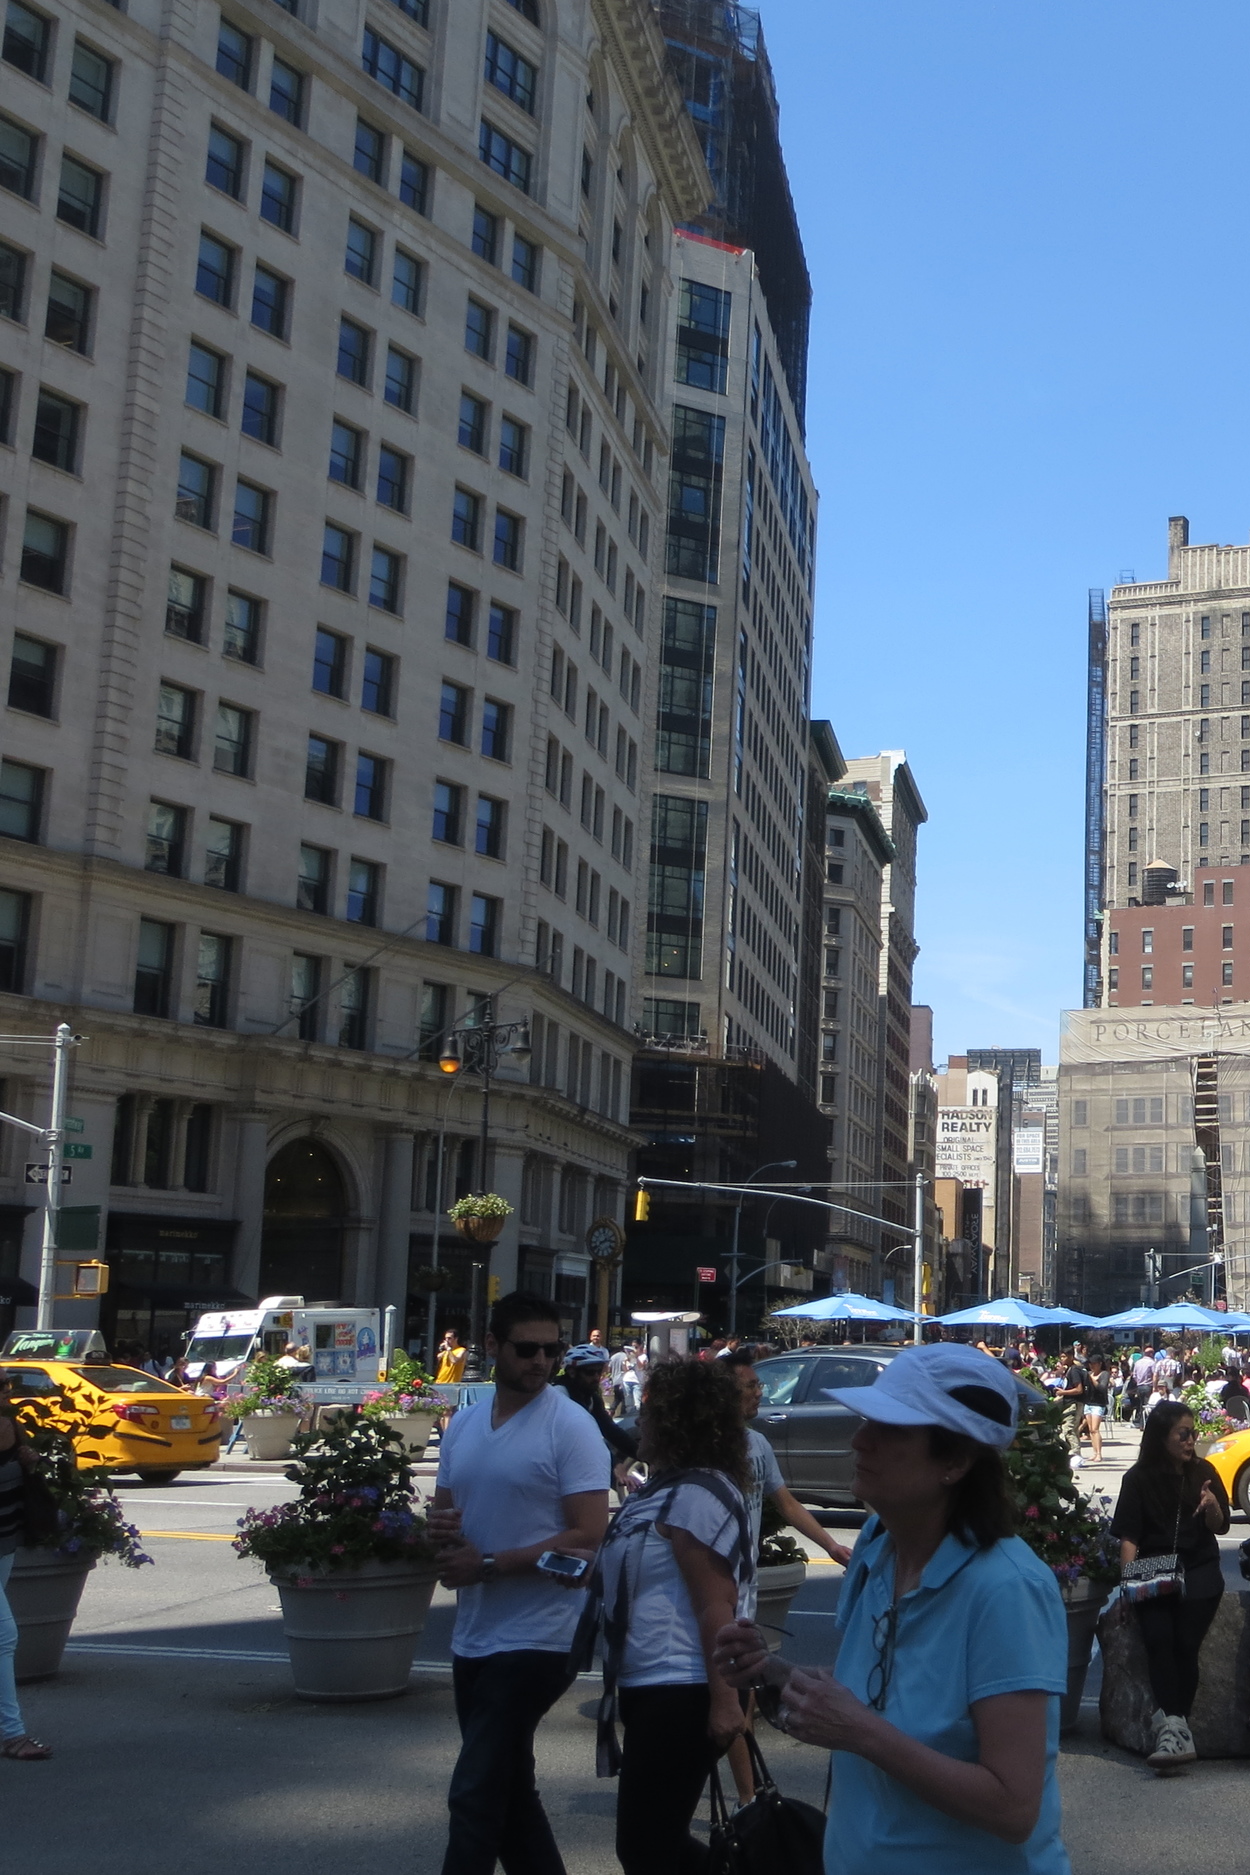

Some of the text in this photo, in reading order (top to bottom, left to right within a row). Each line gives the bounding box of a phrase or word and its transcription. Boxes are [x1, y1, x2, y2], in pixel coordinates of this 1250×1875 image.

[941, 1122, 992, 1133] REALTY
[70, 1145, 75, 1157] 5
[936, 1145, 984, 1153] SMALL SPACE
